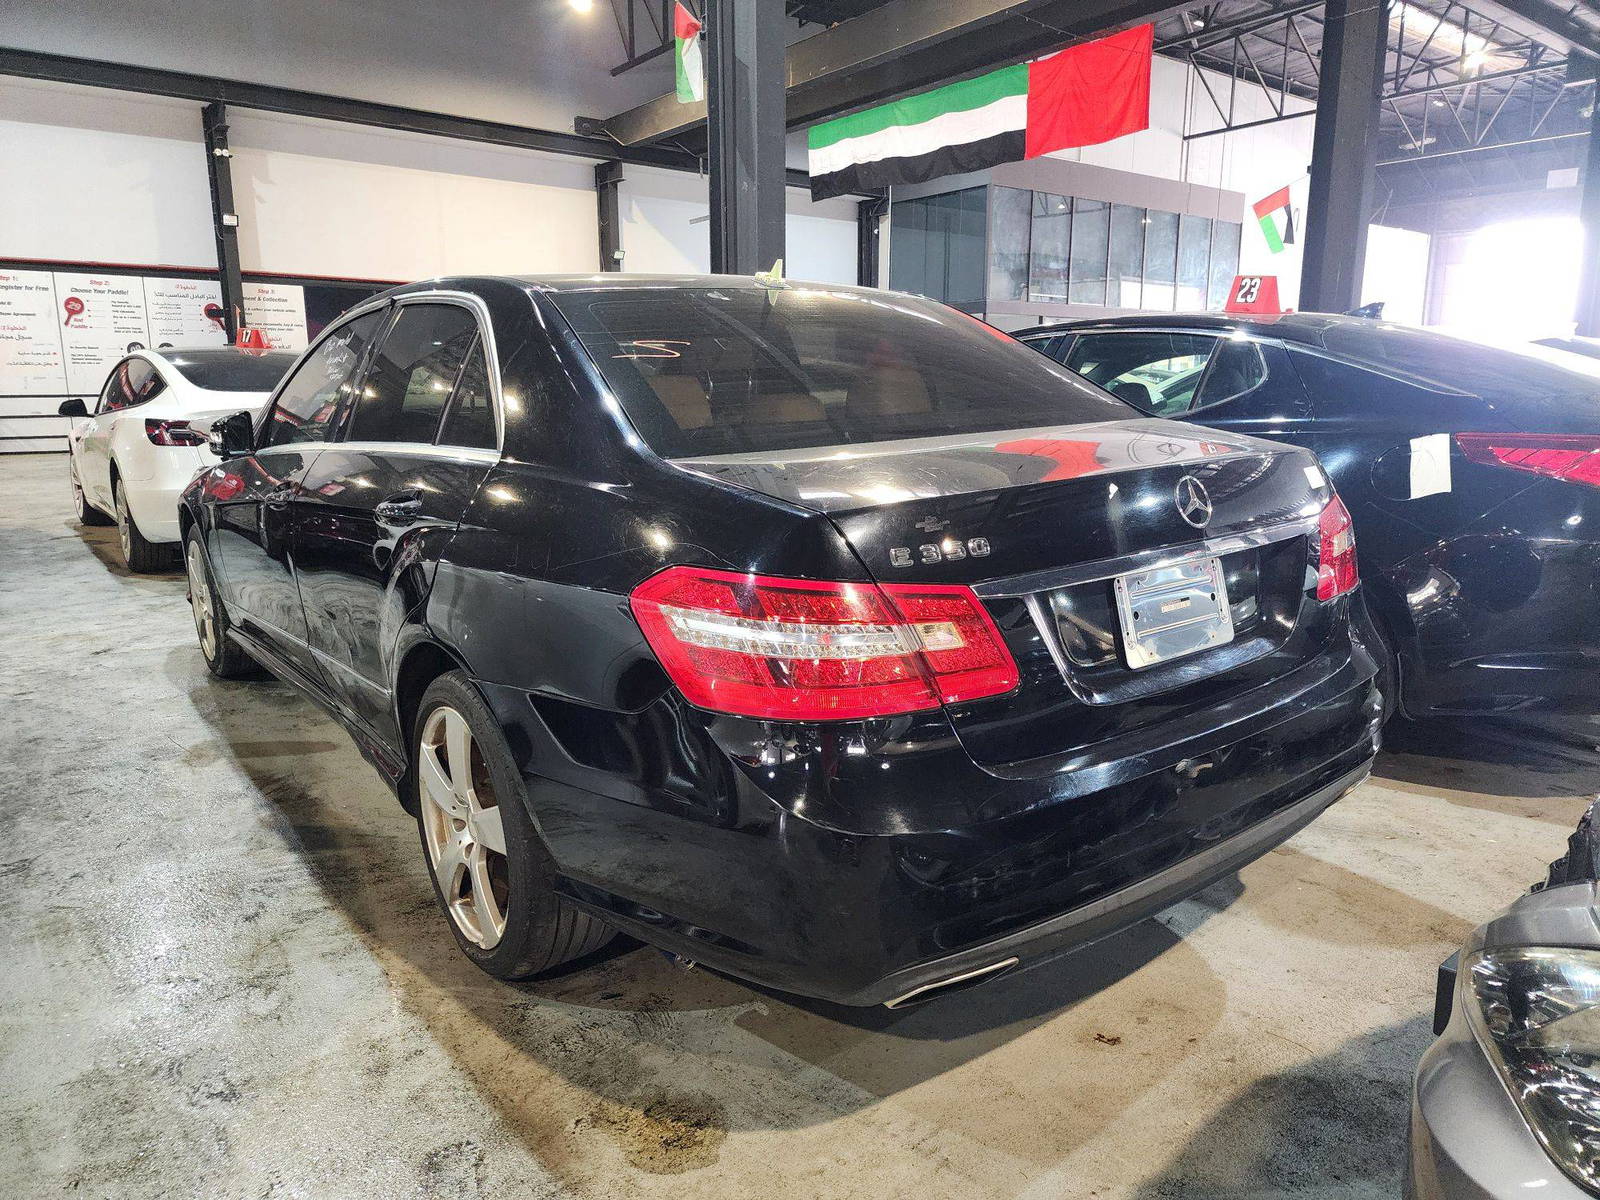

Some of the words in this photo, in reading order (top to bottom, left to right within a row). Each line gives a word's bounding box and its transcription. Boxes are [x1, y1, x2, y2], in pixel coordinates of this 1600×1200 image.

[1235, 278, 1261, 303] 23
[242, 329, 251, 343] 17
[889, 547, 914, 568] E
[919, 537, 991, 565] 350
